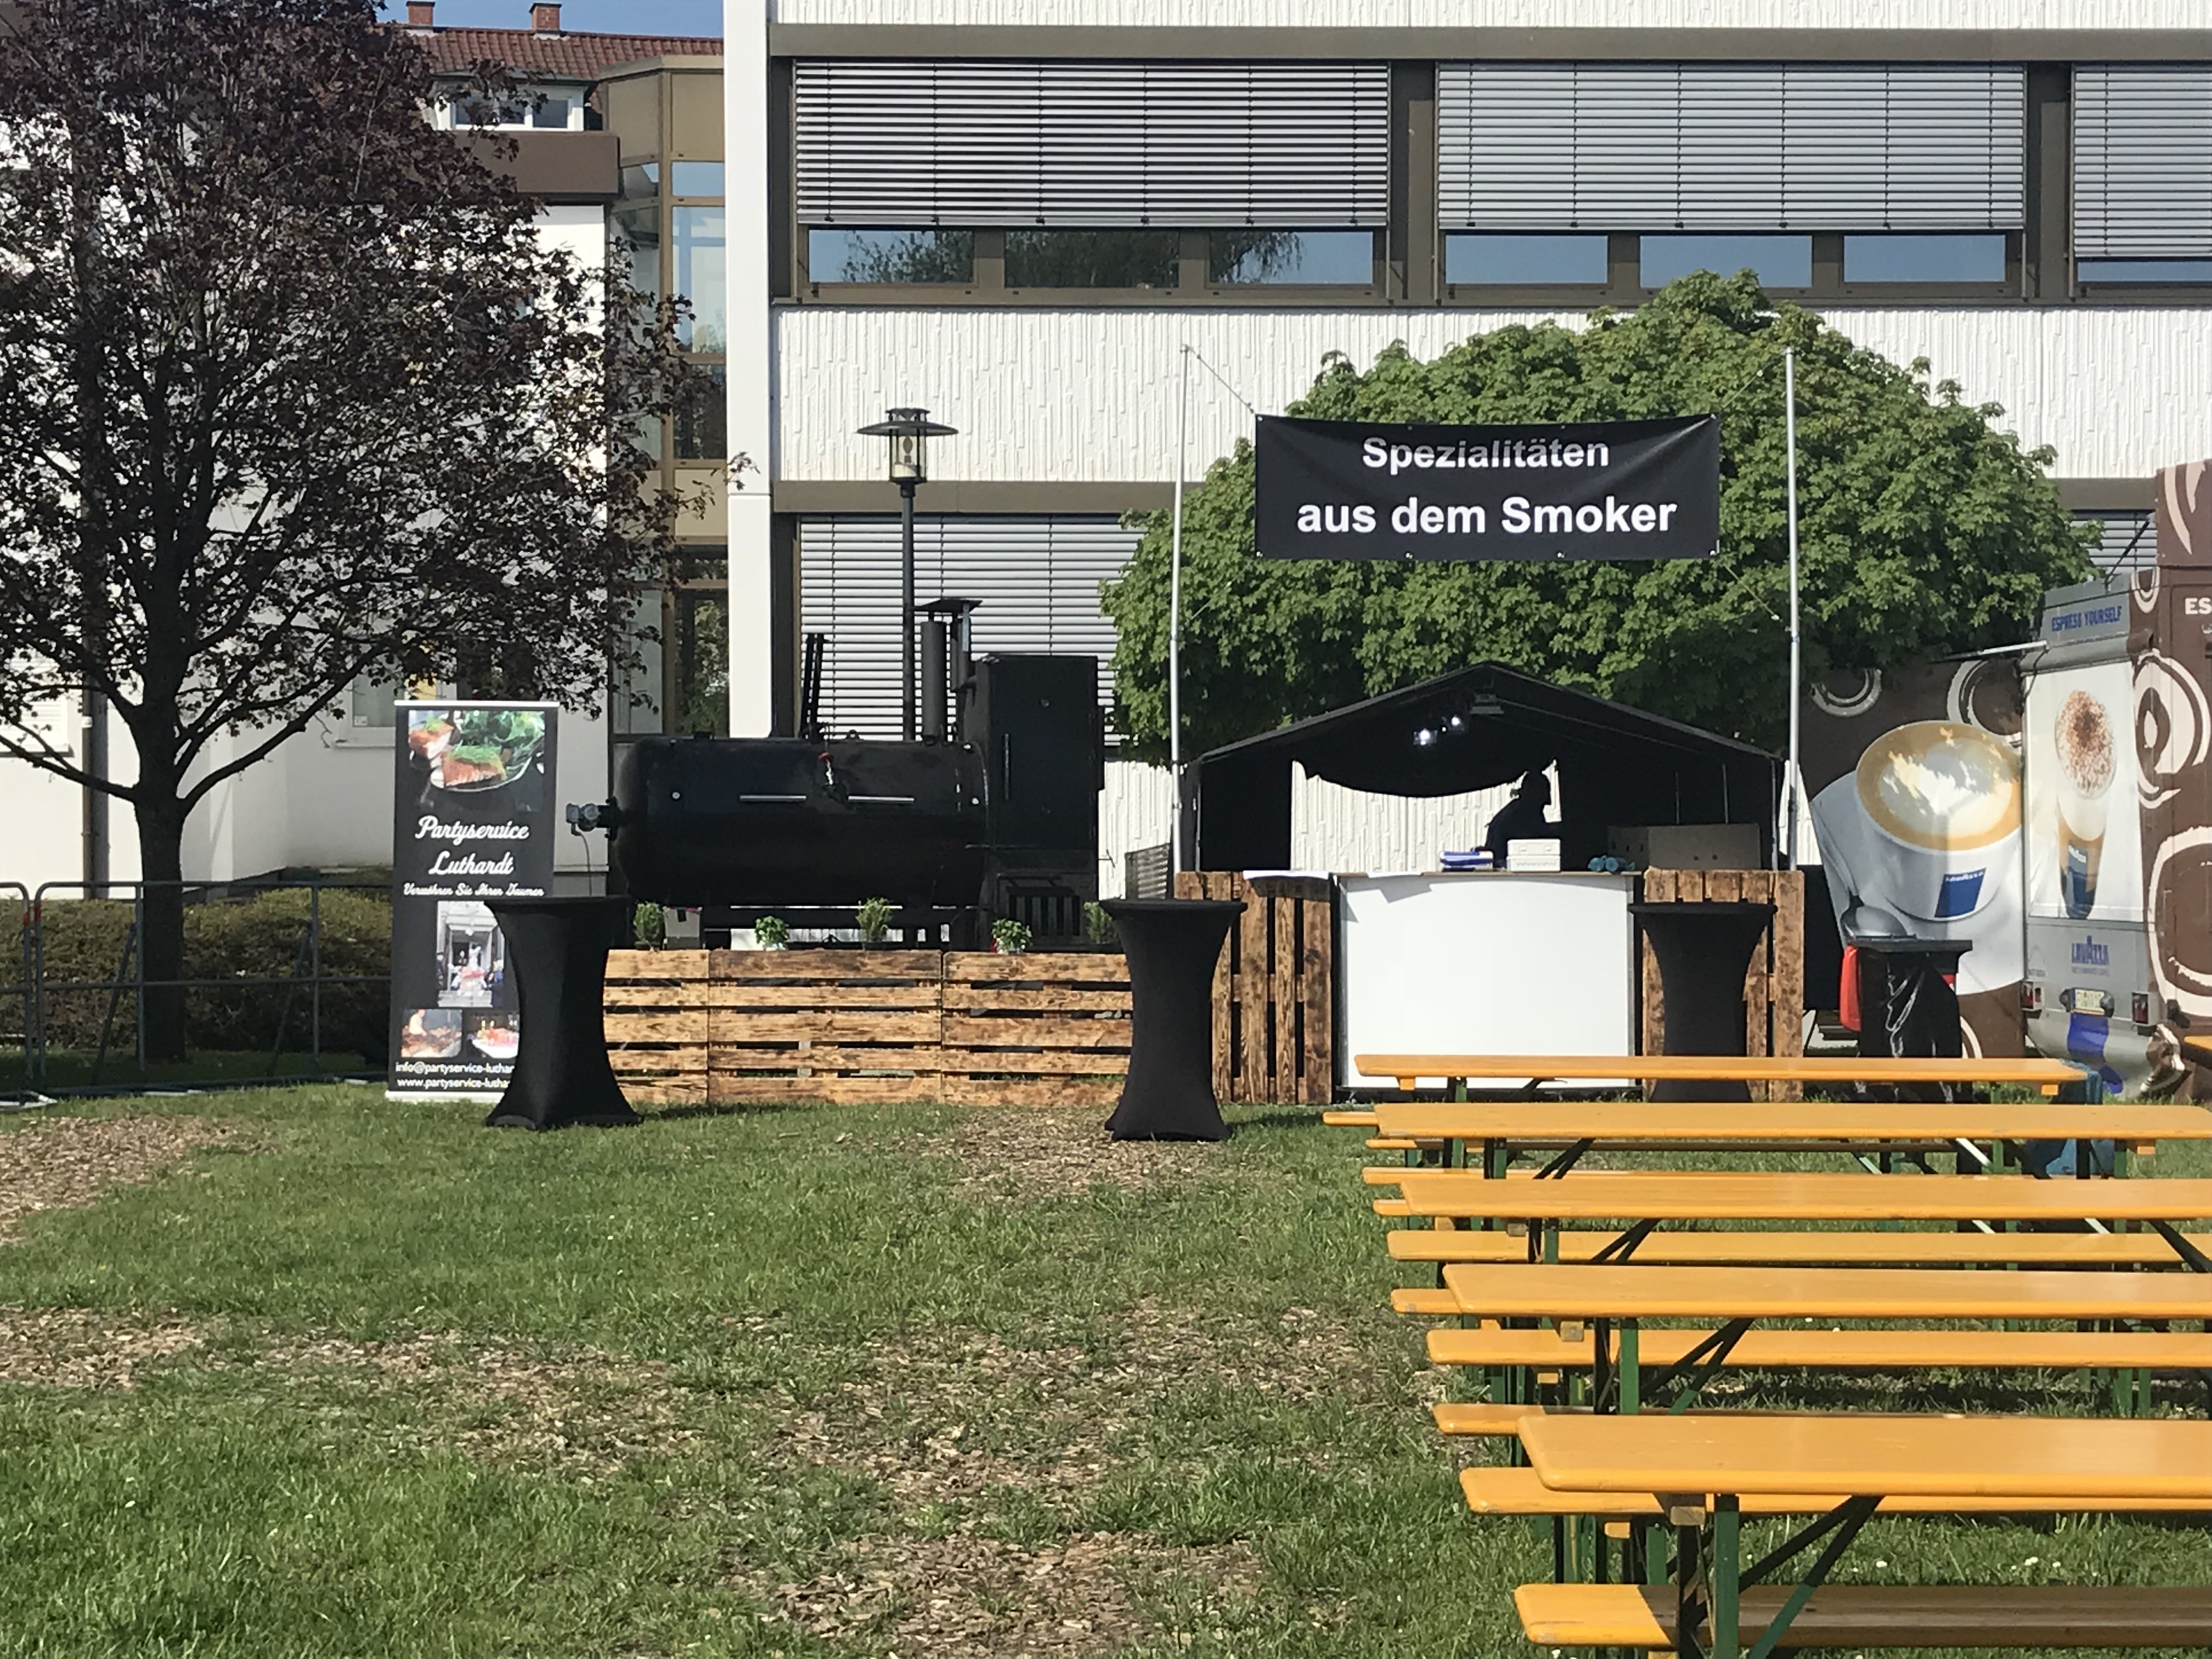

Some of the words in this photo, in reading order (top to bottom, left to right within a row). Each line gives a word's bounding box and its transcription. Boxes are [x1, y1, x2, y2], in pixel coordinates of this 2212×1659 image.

[1362, 437, 1610, 475] Spezialitäten
[1296, 504, 1376, 533] aus
[1391, 497, 1486, 533] dem
[1501, 495, 1677, 533] Smoker
[415, 815, 529, 845] Partyservice
[428, 850, 514, 875] Luthardt
[455, 882, 473, 896] Sie
